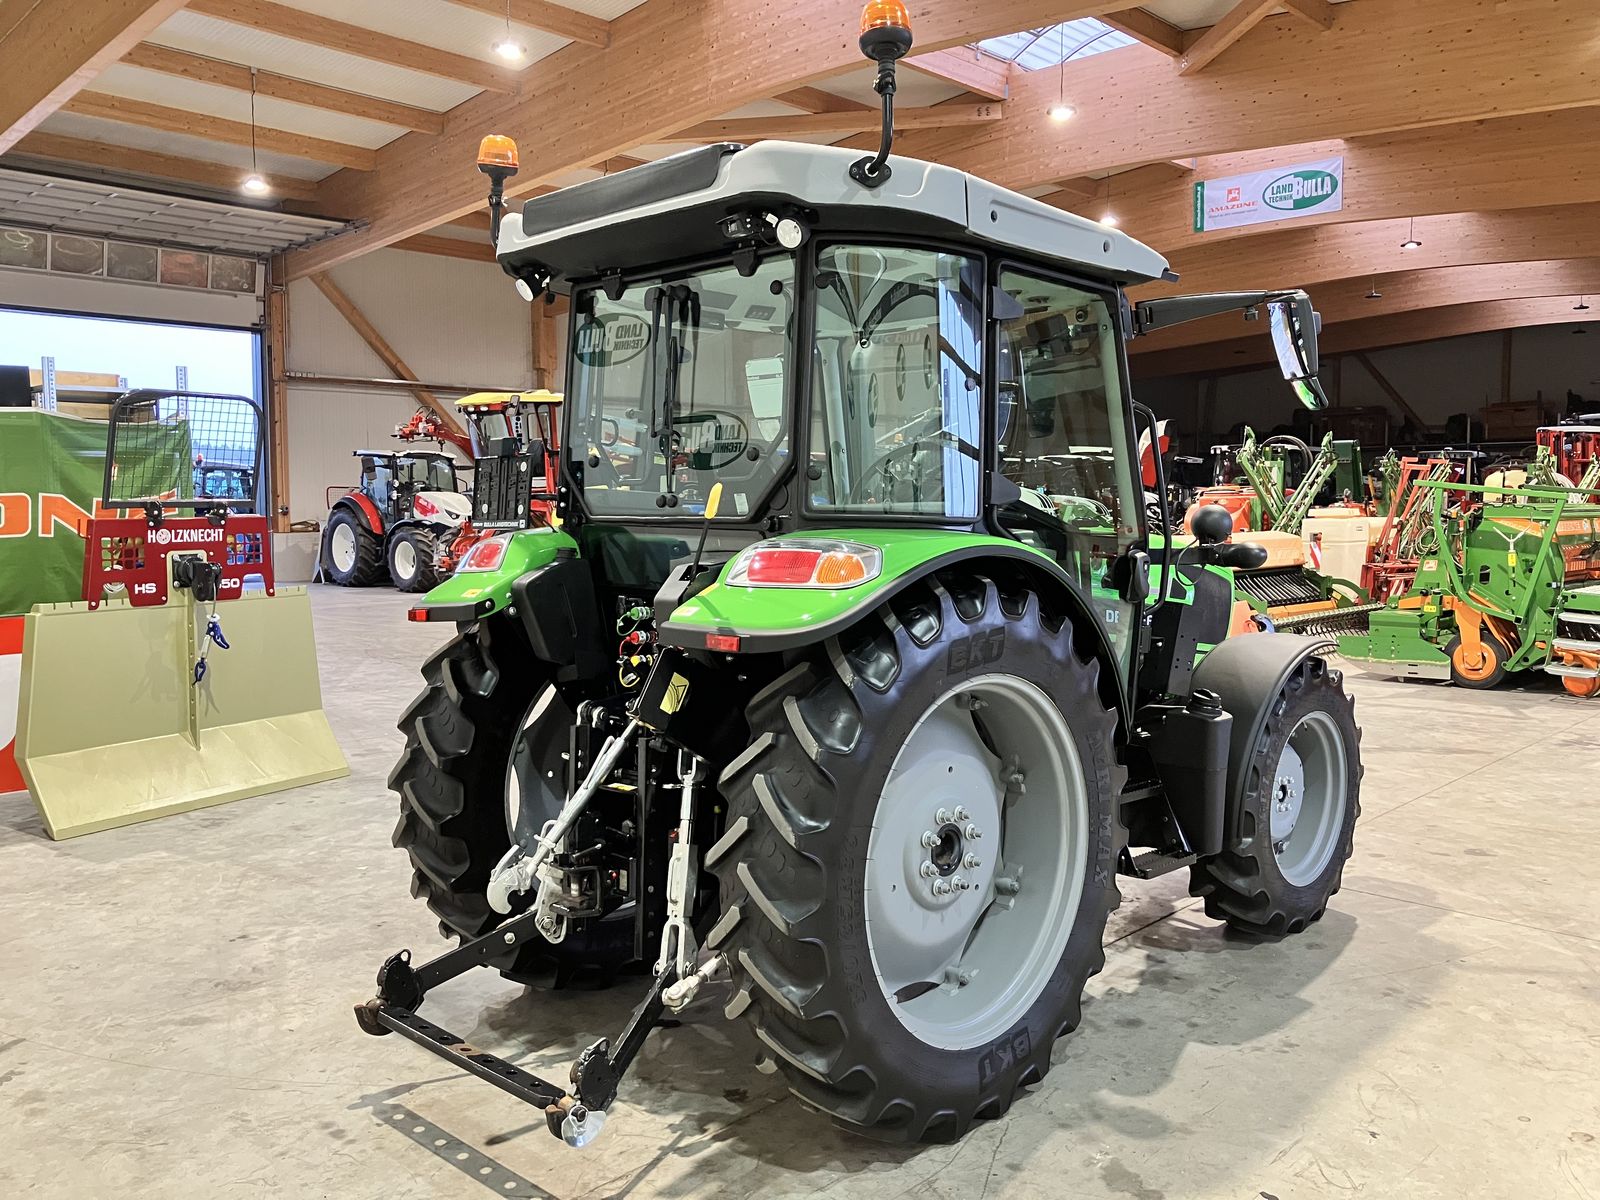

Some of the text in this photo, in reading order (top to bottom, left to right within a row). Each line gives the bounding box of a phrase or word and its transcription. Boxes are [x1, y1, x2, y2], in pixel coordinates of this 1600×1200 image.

[1271, 183, 1293, 196] LAND
[1293, 176, 1332, 200] BULLA
[1269, 194, 1293, 204] TECHNIK
[1208, 201, 1257, 214] AMAZONE
[147, 528, 225, 544] HOLZKNECHT
[134, 578, 240, 595] HS 50
[981, 1030, 1031, 1085] BKT
